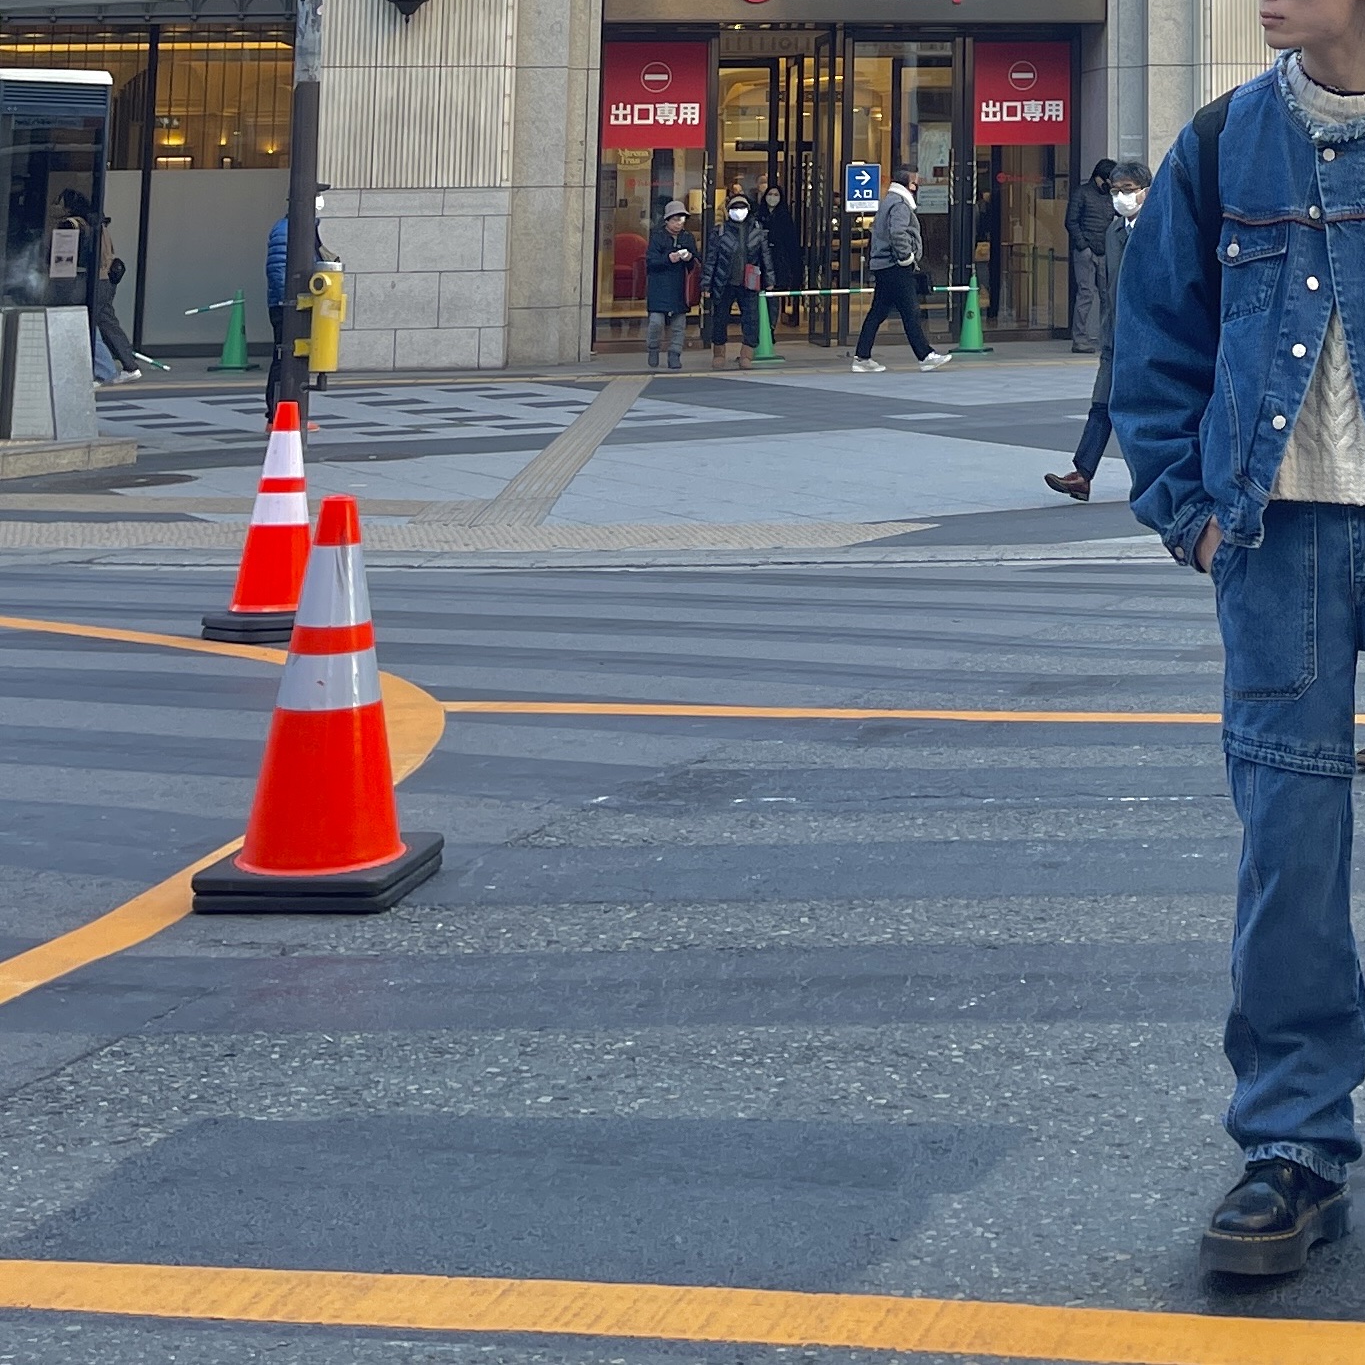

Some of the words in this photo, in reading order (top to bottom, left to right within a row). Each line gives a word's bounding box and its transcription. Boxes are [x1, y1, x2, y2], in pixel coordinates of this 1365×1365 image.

[610, 102, 700, 126] 出口専用
[980, 99, 1064, 123] 出口専用
[853, 189, 873, 199] 入口
